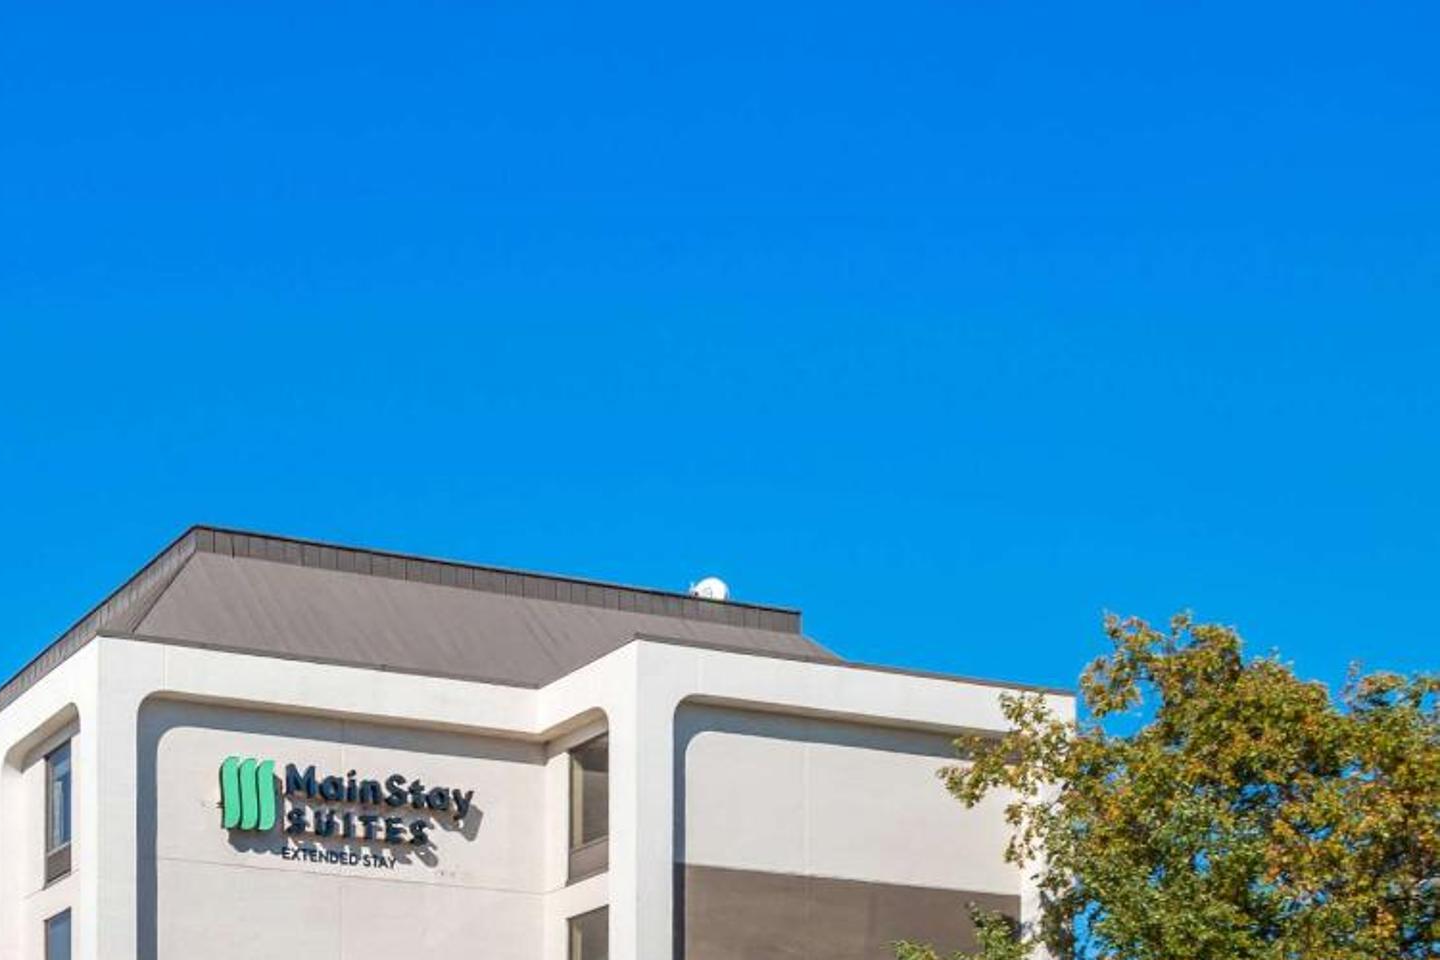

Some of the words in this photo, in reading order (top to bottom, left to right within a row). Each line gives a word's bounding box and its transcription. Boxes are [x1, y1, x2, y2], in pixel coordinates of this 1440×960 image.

[285, 763, 474, 820] MainStay
[286, 807, 431, 846] SUITES
[281, 846, 361, 866] EXTENDED
[363, 854, 398, 869] STAY
